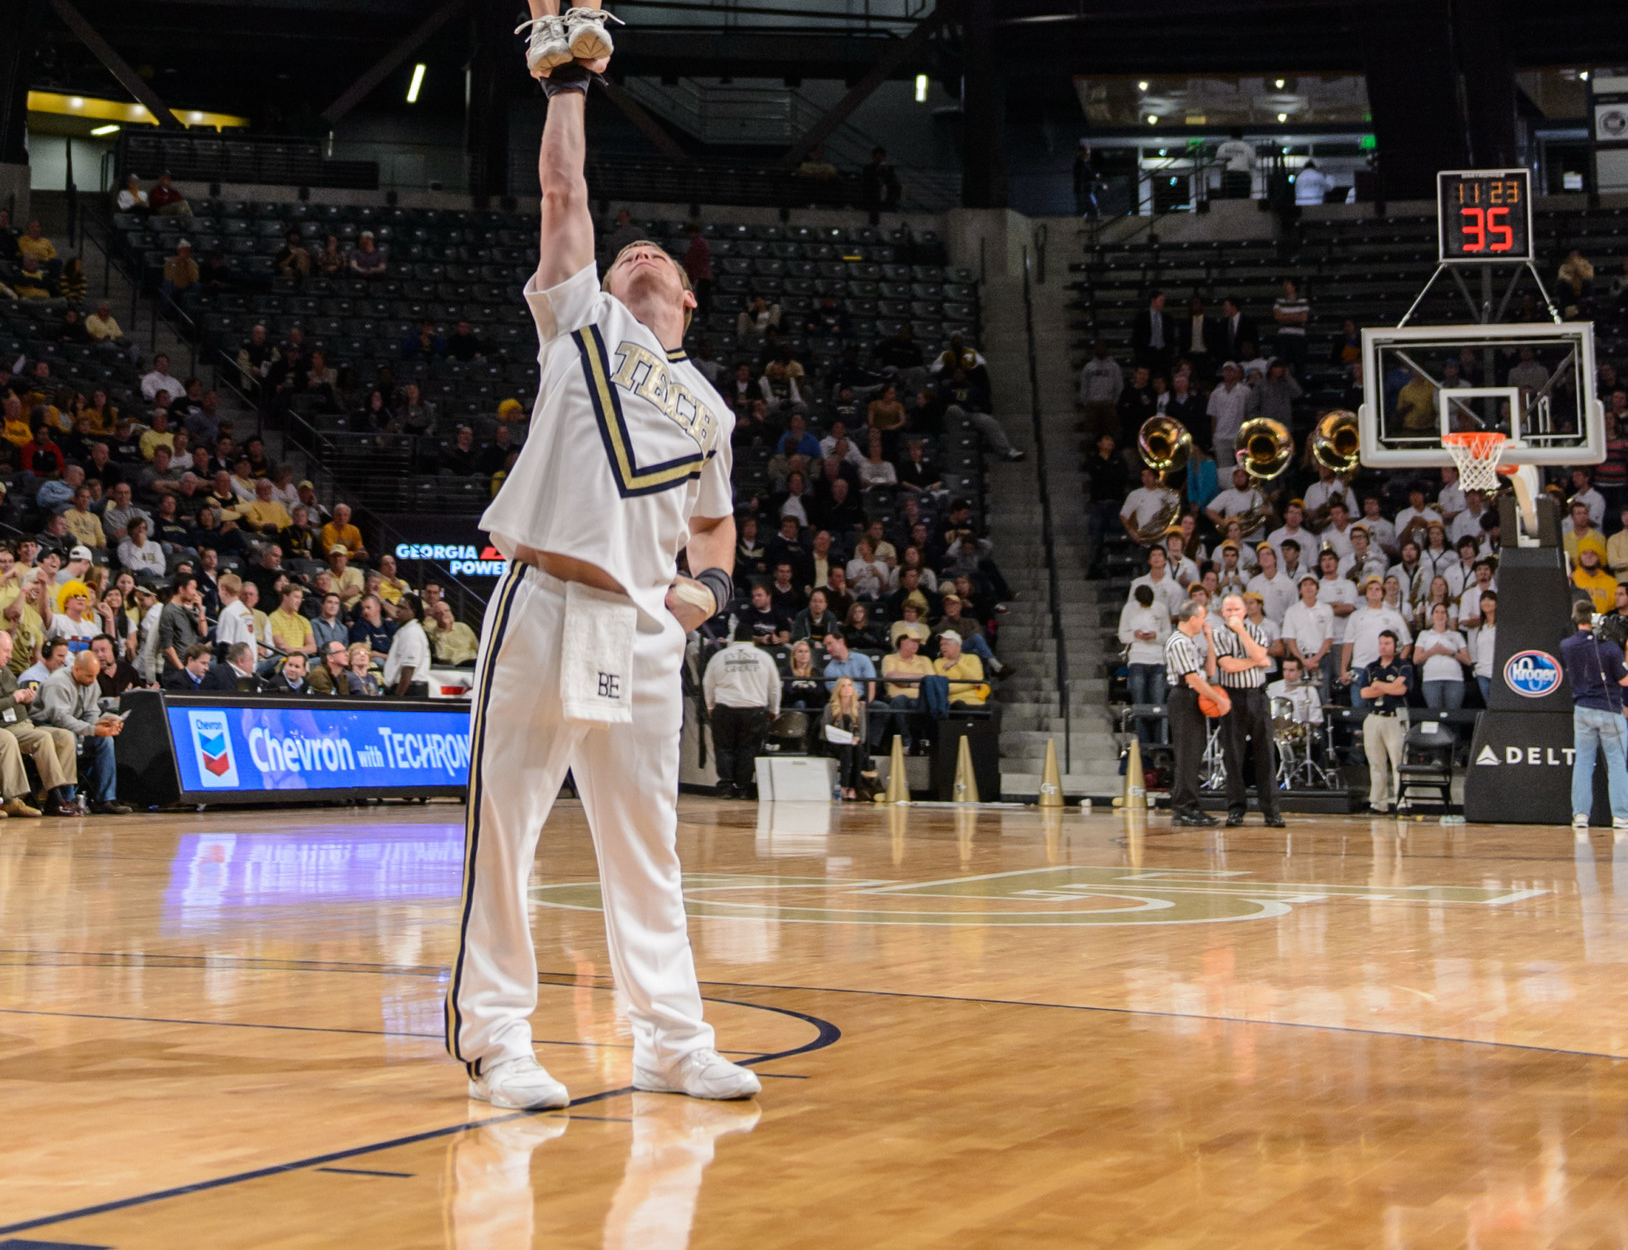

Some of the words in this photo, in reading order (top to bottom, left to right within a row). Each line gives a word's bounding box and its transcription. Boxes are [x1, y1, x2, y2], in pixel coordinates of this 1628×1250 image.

[1461, 206, 1513, 251] 35
[610, 340, 718, 460] TECH
[396, 543, 478, 560] GEORGIA
[598, 672, 620, 699] BE
[196, 718, 223, 730] Chevron
[250, 727, 355, 773] Chevron
[357, 742, 384, 768] with
[378, 726, 470, 777] TECHRON
[1505, 747, 1576, 766] DELT
